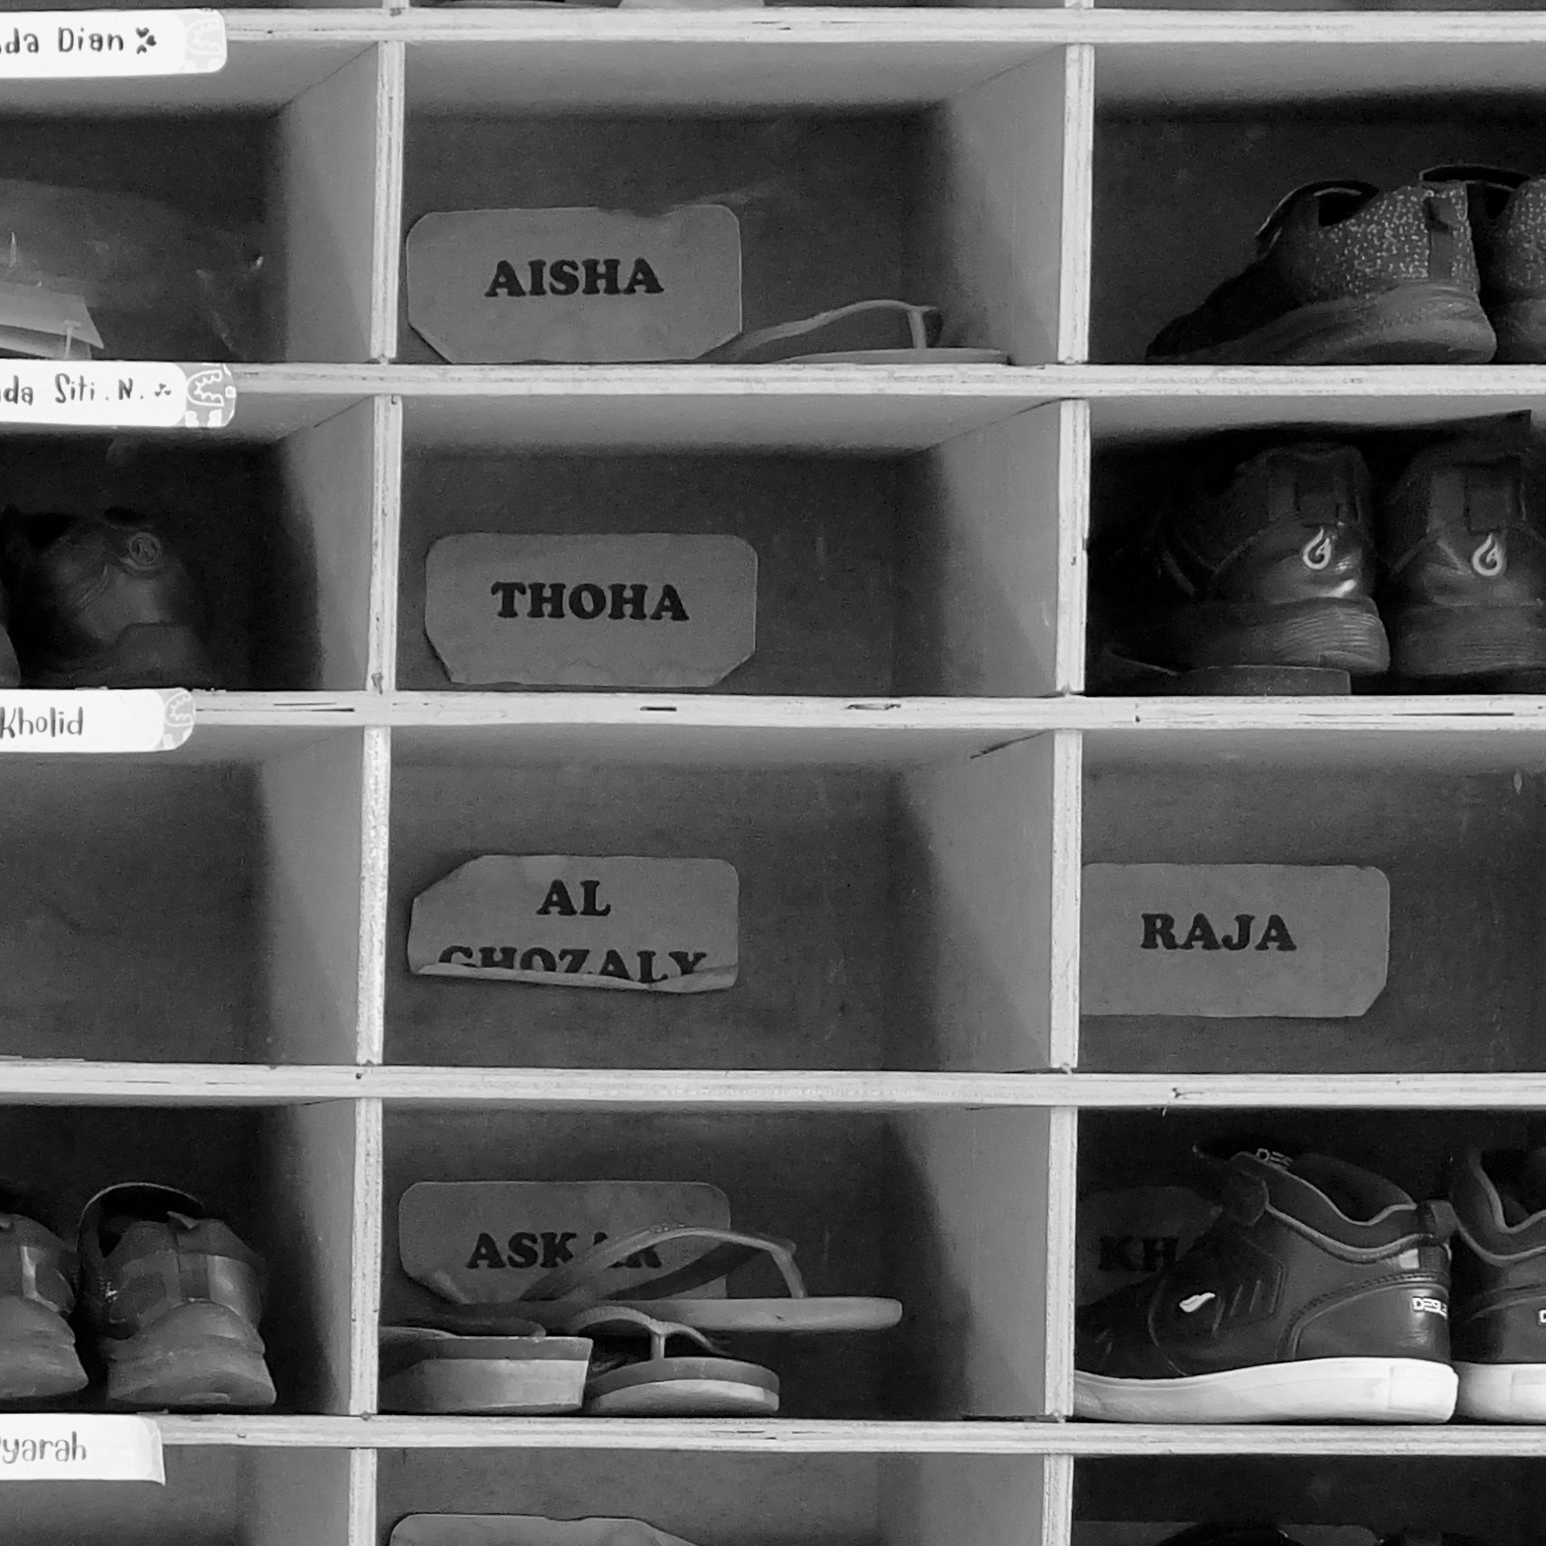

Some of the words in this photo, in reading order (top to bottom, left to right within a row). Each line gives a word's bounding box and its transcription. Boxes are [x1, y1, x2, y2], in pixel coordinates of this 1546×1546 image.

[58, 28, 124, 52] Dian
[485, 258, 664, 297] AISHA
[491, 582, 689, 621] THOHA
[0, 707, 83, 739] Kholid
[537, 880, 611, 916] AL
[1141, 913, 1296, 951] RAJA
